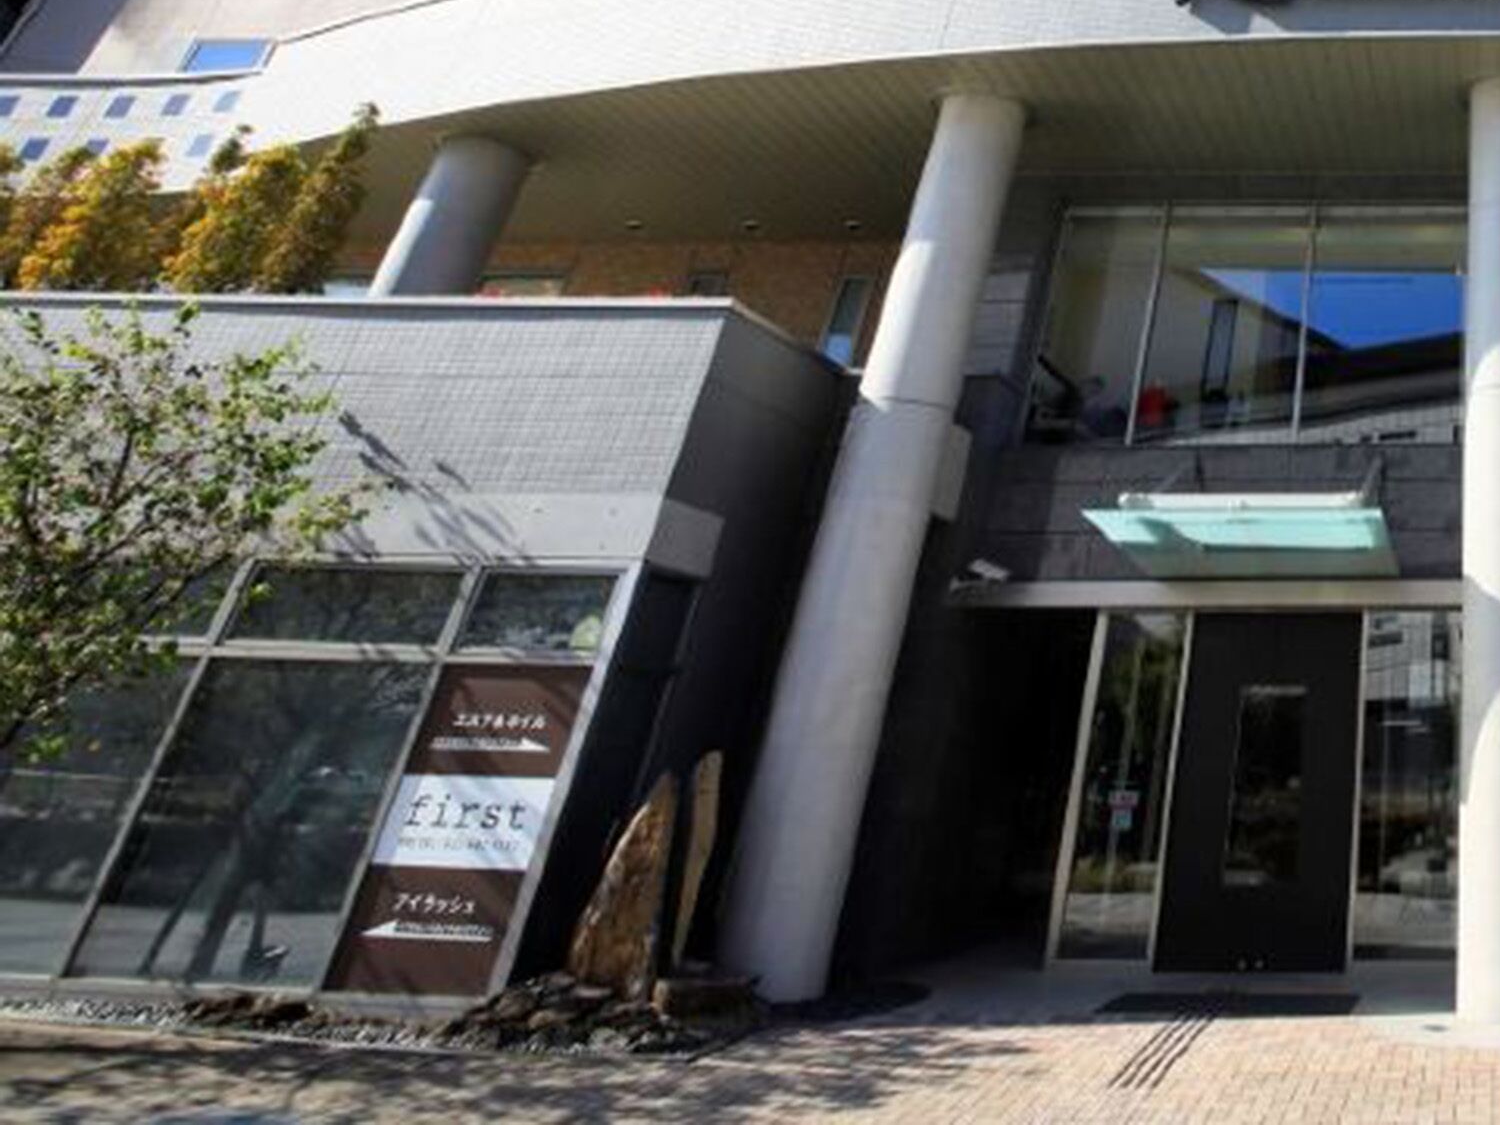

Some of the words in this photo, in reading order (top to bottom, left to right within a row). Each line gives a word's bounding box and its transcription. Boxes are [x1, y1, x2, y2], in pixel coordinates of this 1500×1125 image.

[403, 793, 526, 830] first
[392, 892, 476, 914] アイラッシュ
